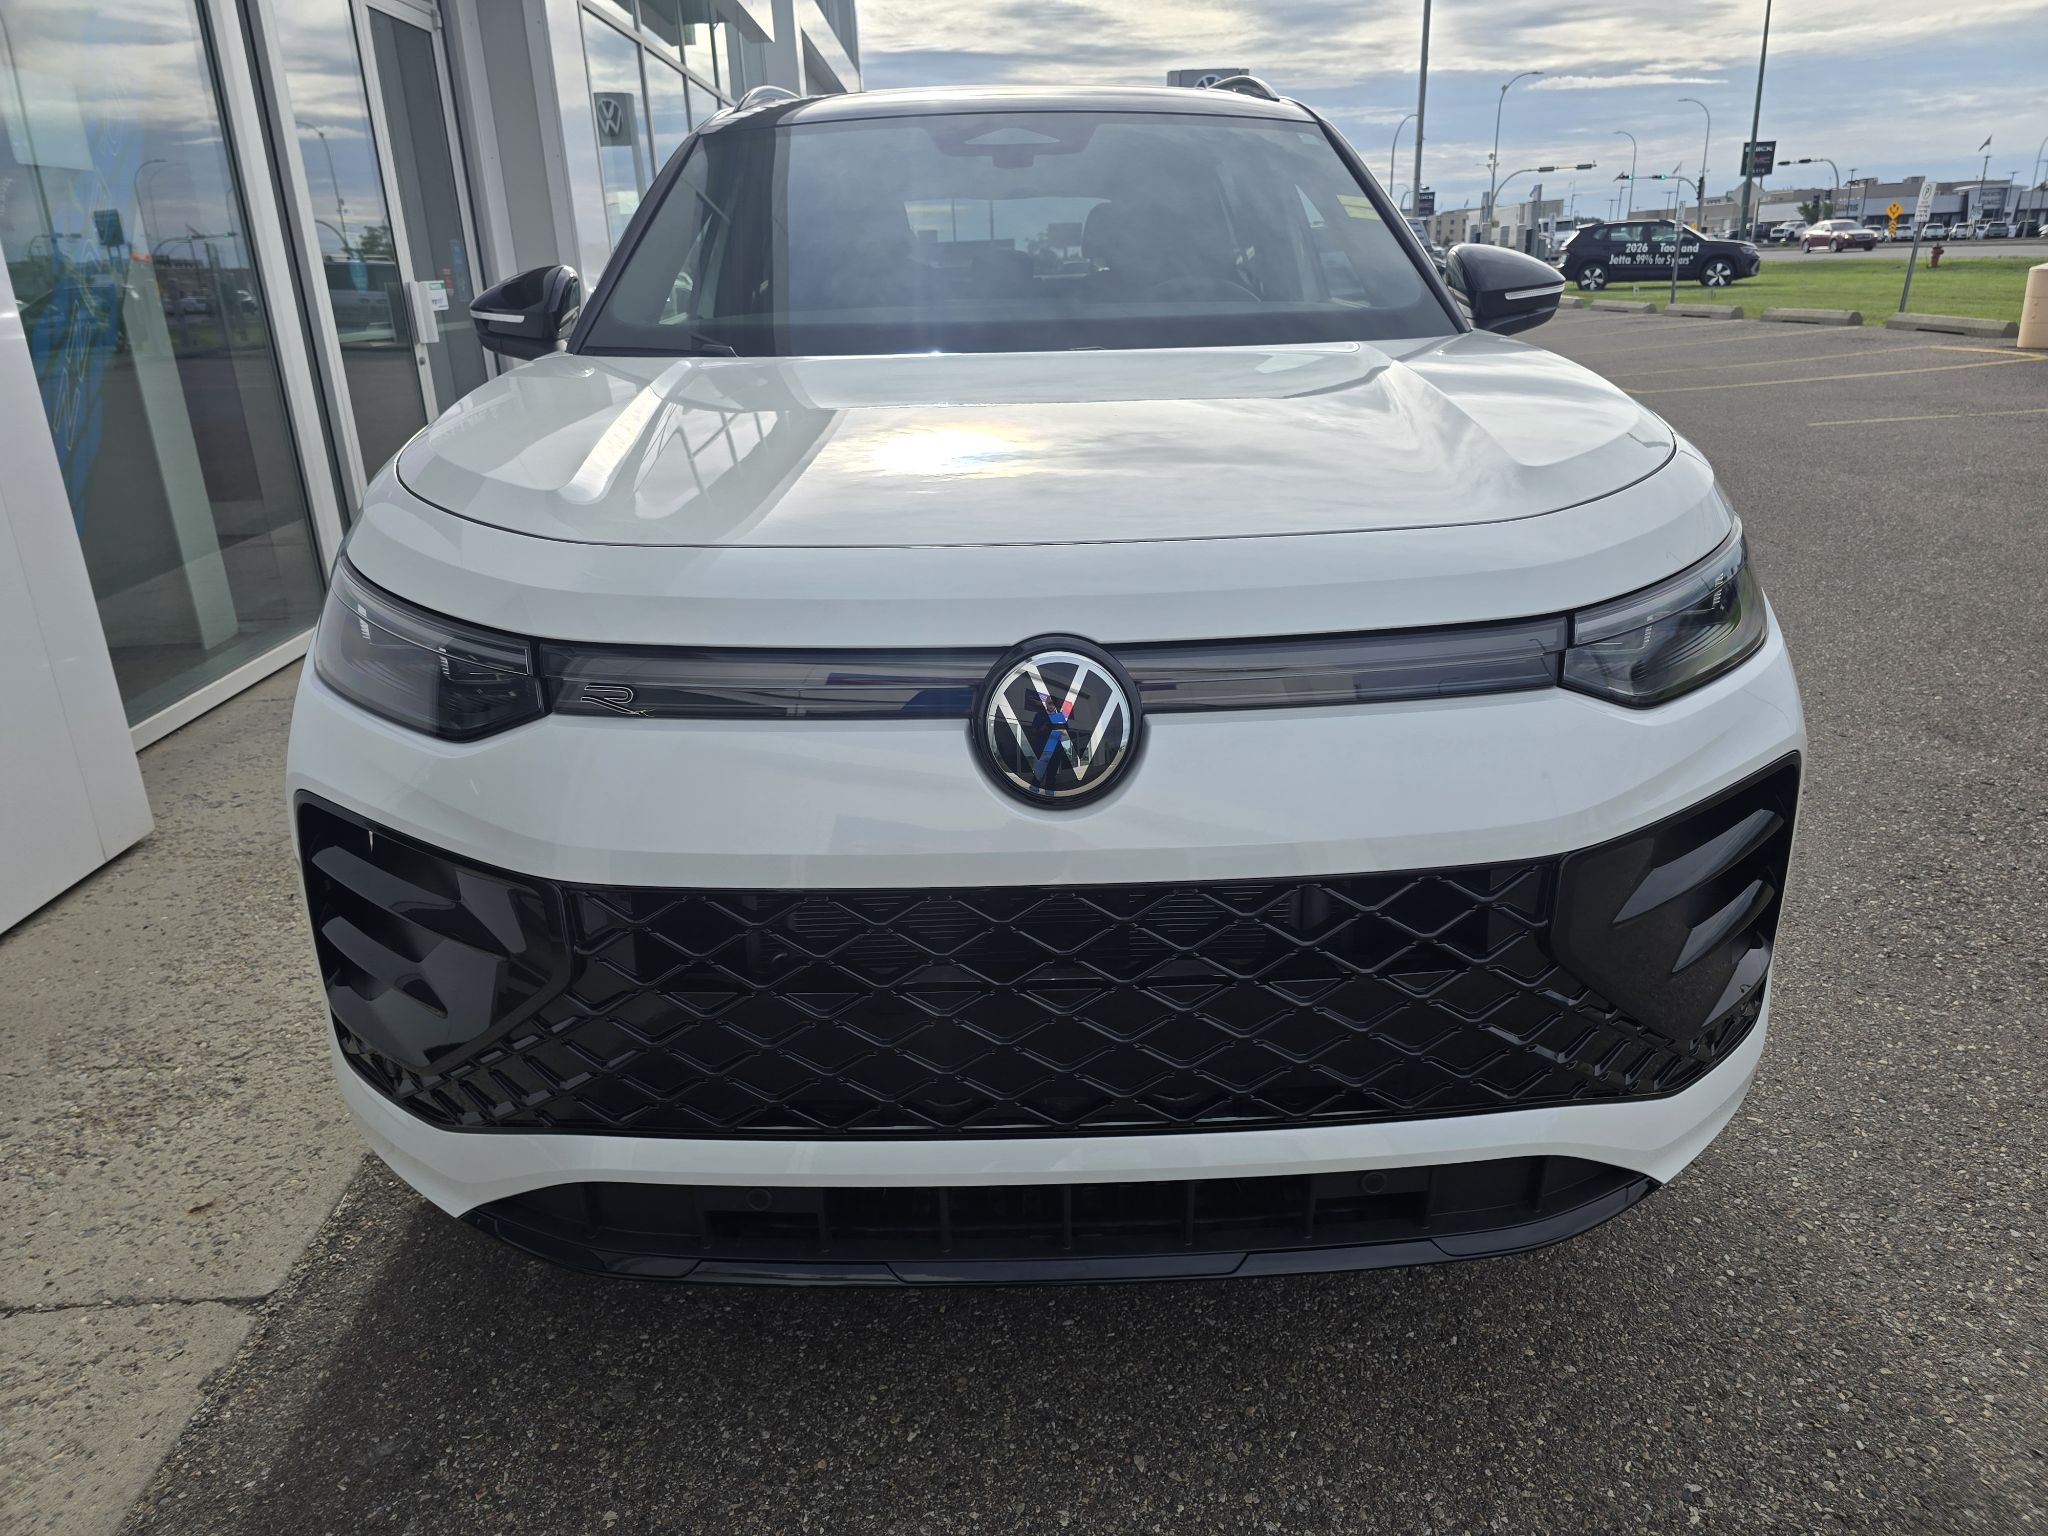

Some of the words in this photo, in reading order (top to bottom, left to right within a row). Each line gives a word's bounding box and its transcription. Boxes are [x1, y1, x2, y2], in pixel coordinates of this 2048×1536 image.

[1625, 242, 1649, 253] 2026
[1660, 242, 1678, 253] Tao
[1681, 242, 1700, 253] and
[1609, 253, 1631, 265] Jetta
[1633, 253, 1653, 265] .99%
[1654, 253, 1666, 265] for
